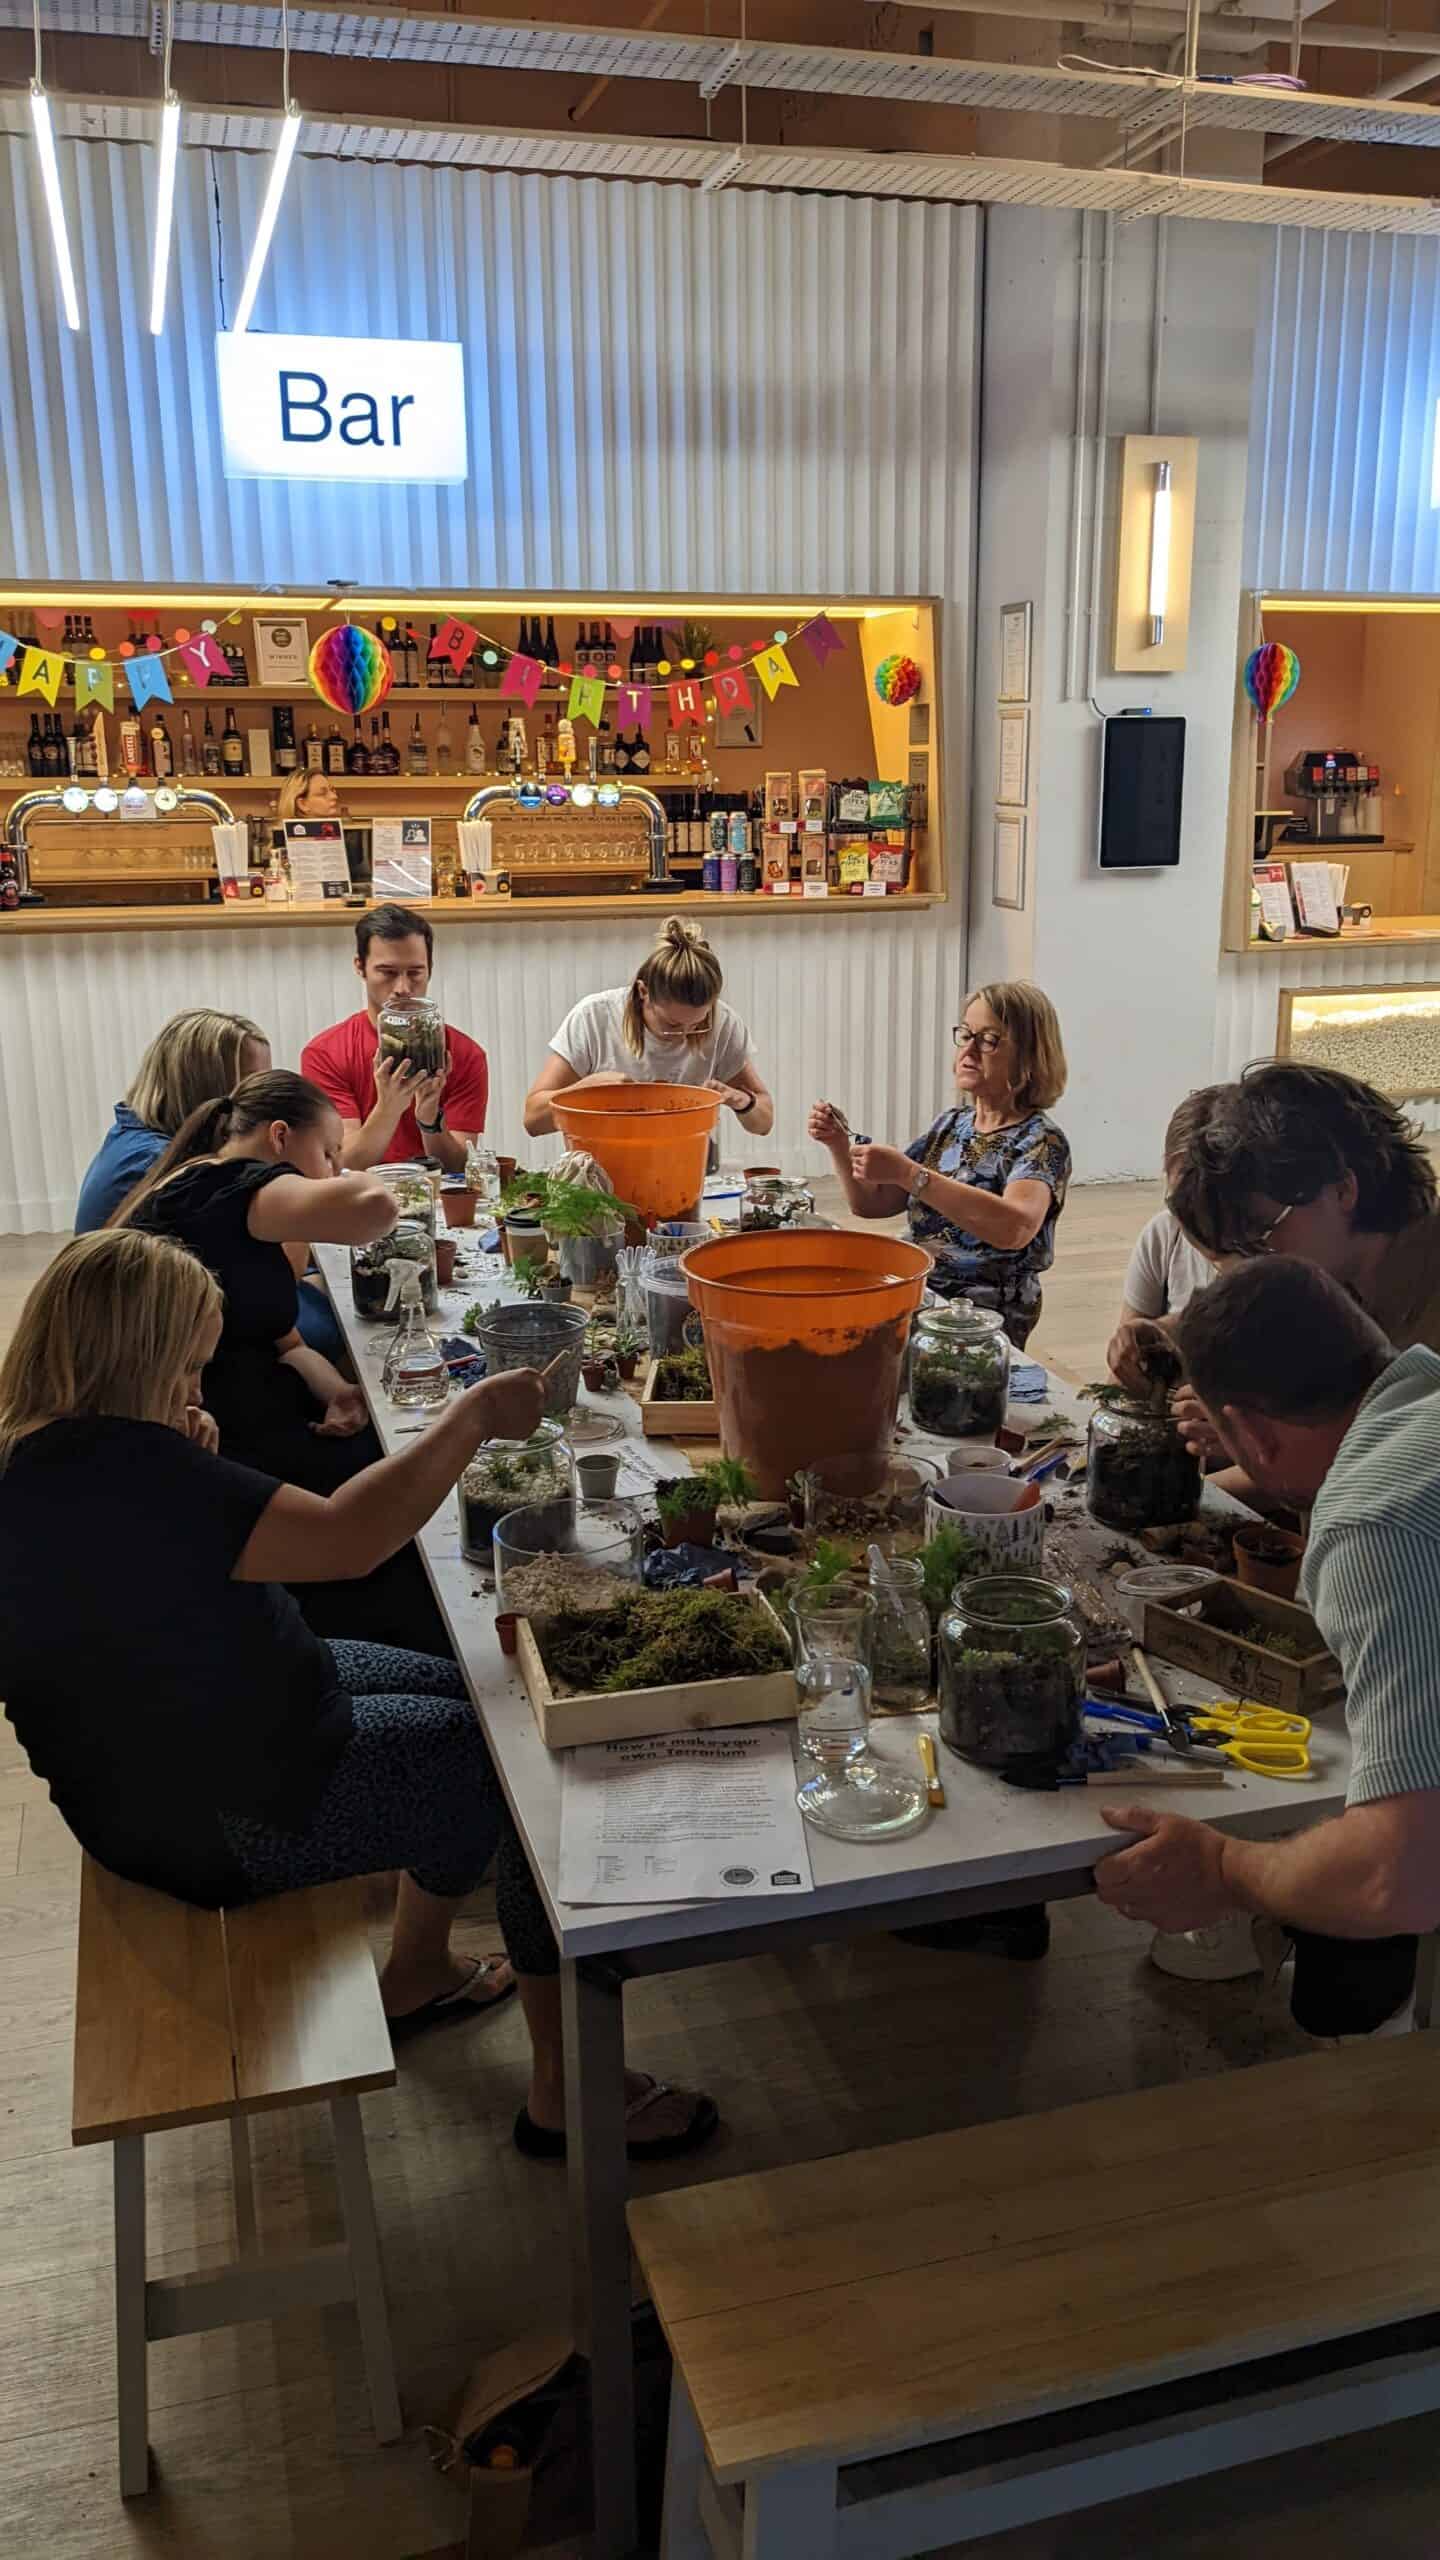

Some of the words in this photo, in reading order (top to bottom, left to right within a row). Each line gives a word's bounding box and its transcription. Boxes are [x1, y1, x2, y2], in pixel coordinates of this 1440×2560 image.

[278, 370, 415, 446] Bar
[0, 639, 211, 692] APPY
[606, 1742, 645, 1752] How
[671, 1736, 717, 1747] make
[620, 1751, 657, 1761] own
[665, 1748, 747, 1758] Terrarium
